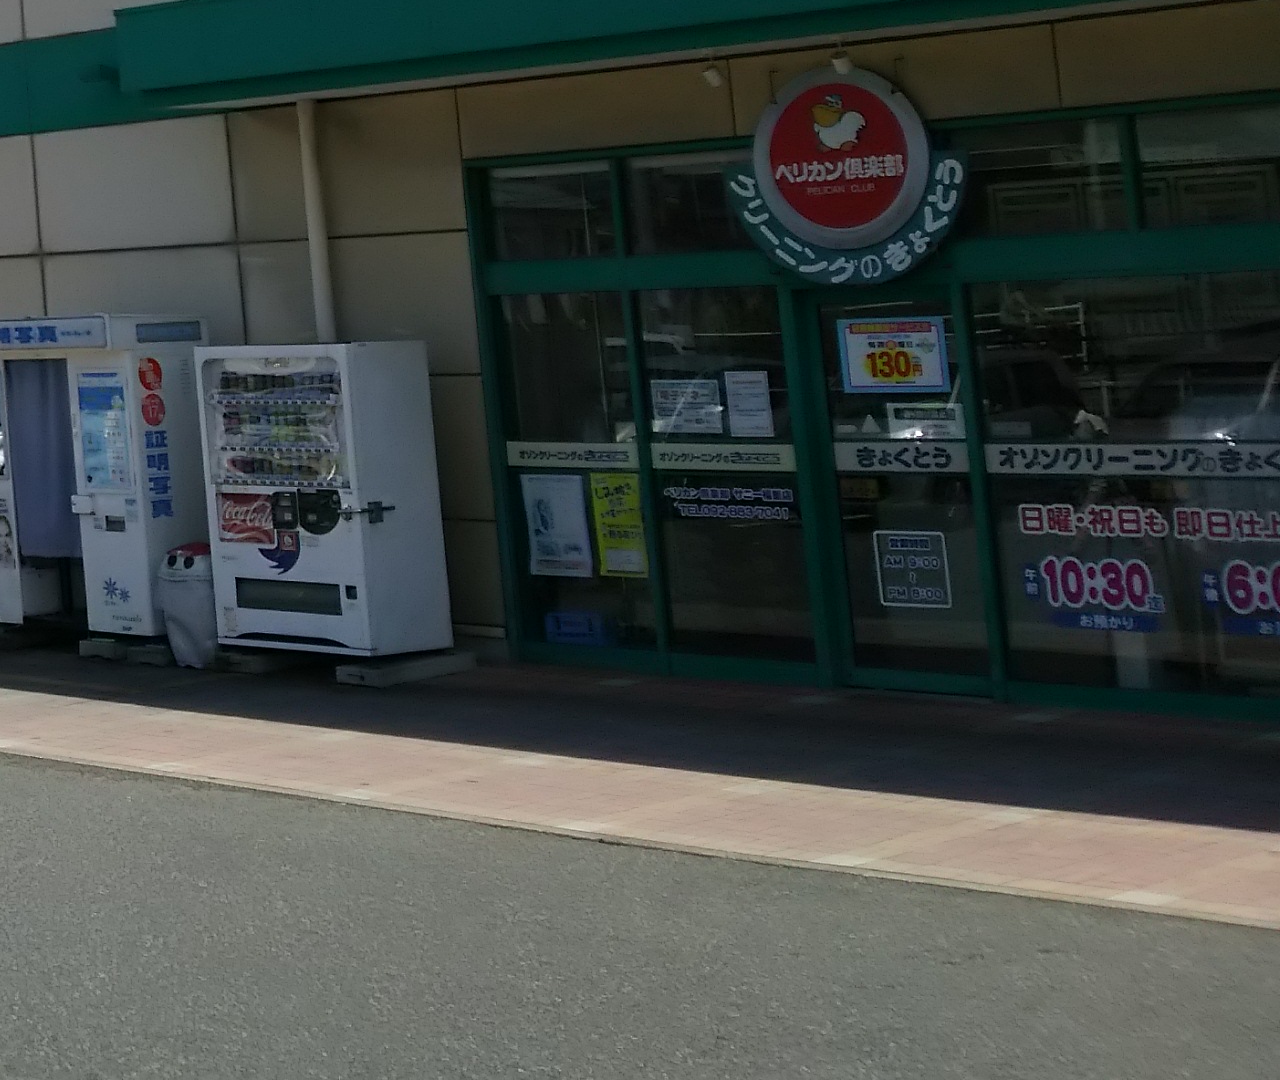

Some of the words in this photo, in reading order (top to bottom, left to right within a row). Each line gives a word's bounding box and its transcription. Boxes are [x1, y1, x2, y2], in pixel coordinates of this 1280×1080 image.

[775, 154, 904, 183] ペリカン倶楽部
[807, 184, 845, 196] PELICAN
[850, 182, 876, 193] CLUB
[730, 158, 964, 284] クリーニングのきょくとう
[856, 446, 953, 470] きょくとう
[144, 430, 174, 519] 証明写真
[1018, 503, 1168, 537] 日曜・祝日も
[884, 555, 903, 568] AM
[908, 556, 940, 569] 9:00
[888, 586, 907, 599] PM
[911, 587, 944, 600] 8:00
[1042, 556, 1153, 612] 10:30
